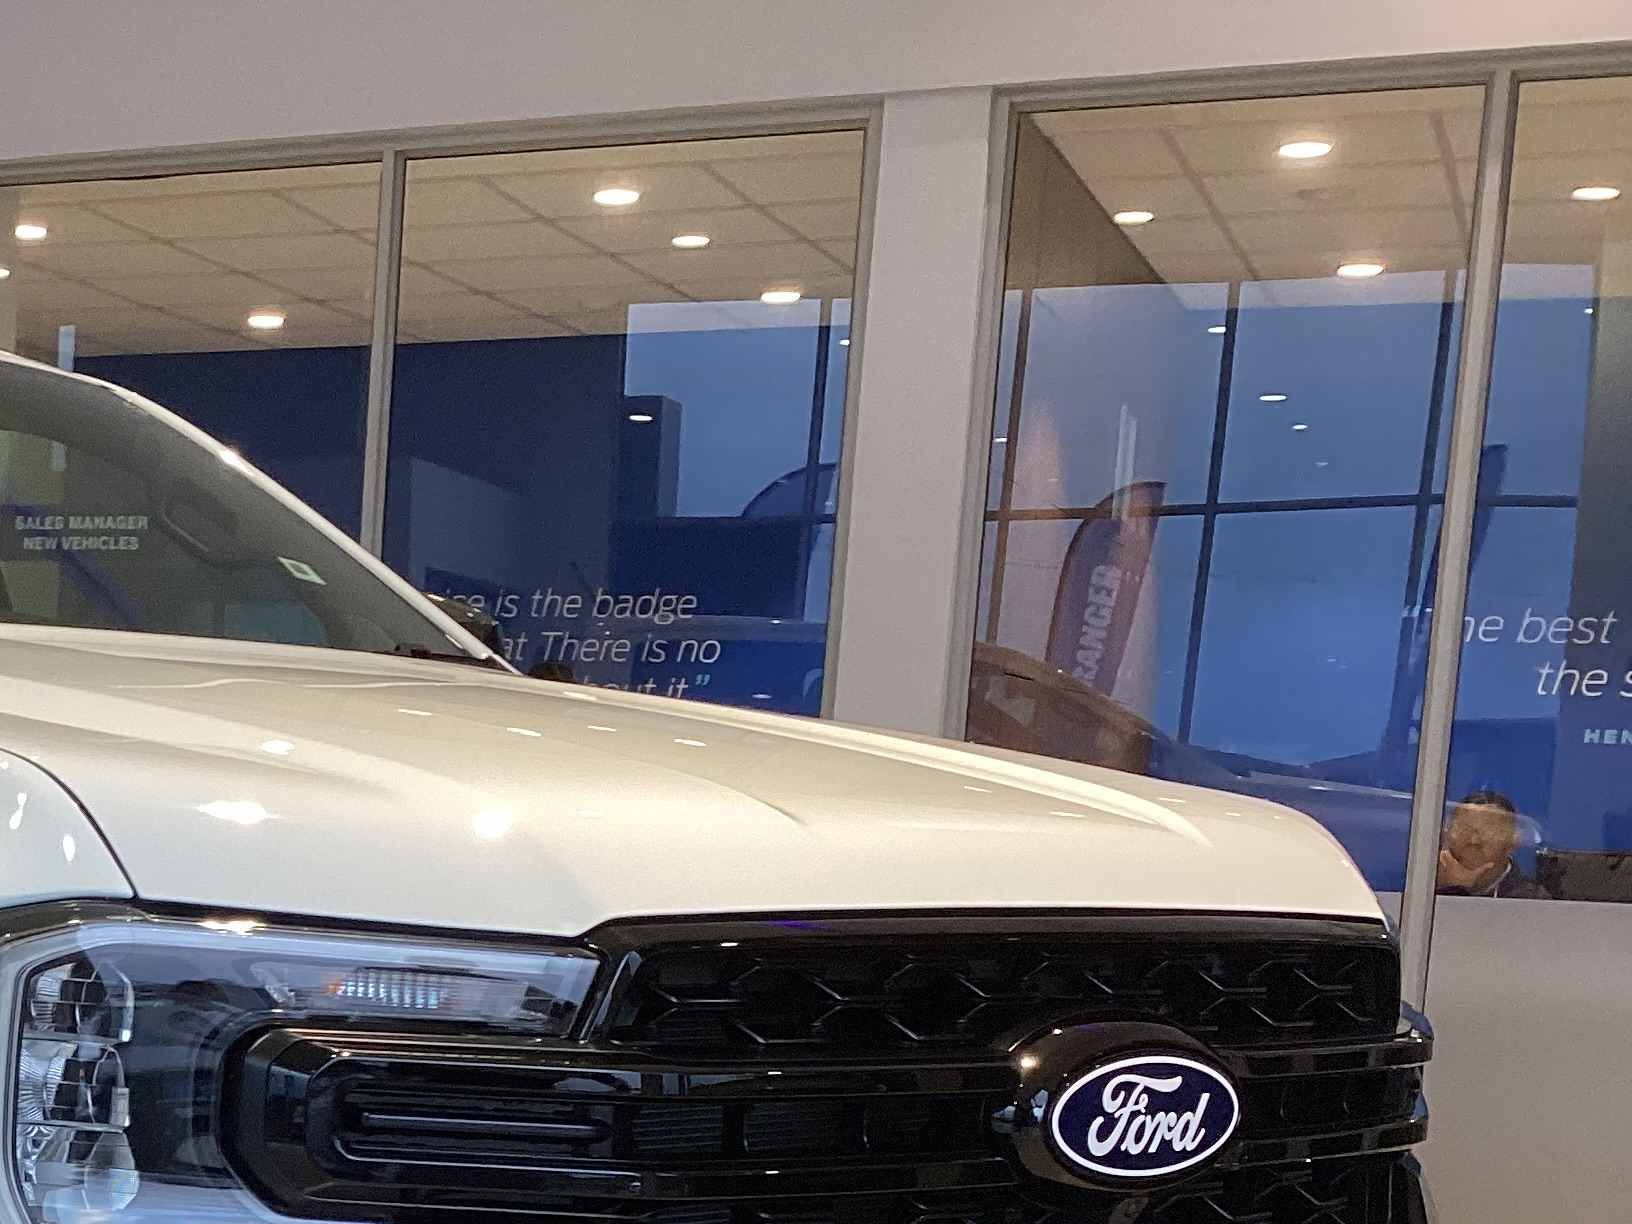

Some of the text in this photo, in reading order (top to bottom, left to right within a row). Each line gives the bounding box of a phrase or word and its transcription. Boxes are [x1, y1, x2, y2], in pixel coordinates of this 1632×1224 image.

[14, 515, 149, 530] SALES MANAGER
[23, 536, 139, 550] NEW VEHICLES
[494, 588, 519, 619] is
[530, 588, 582, 619] the
[592, 587, 698, 625] badge
[1515, 608, 1618, 645] best
[541, 631, 631, 662] There
[640, 633, 667, 663] is
[676, 638, 721, 664] no
[1535, 659, 1609, 697] the
[1087, 1073, 1211, 1157] Ford
